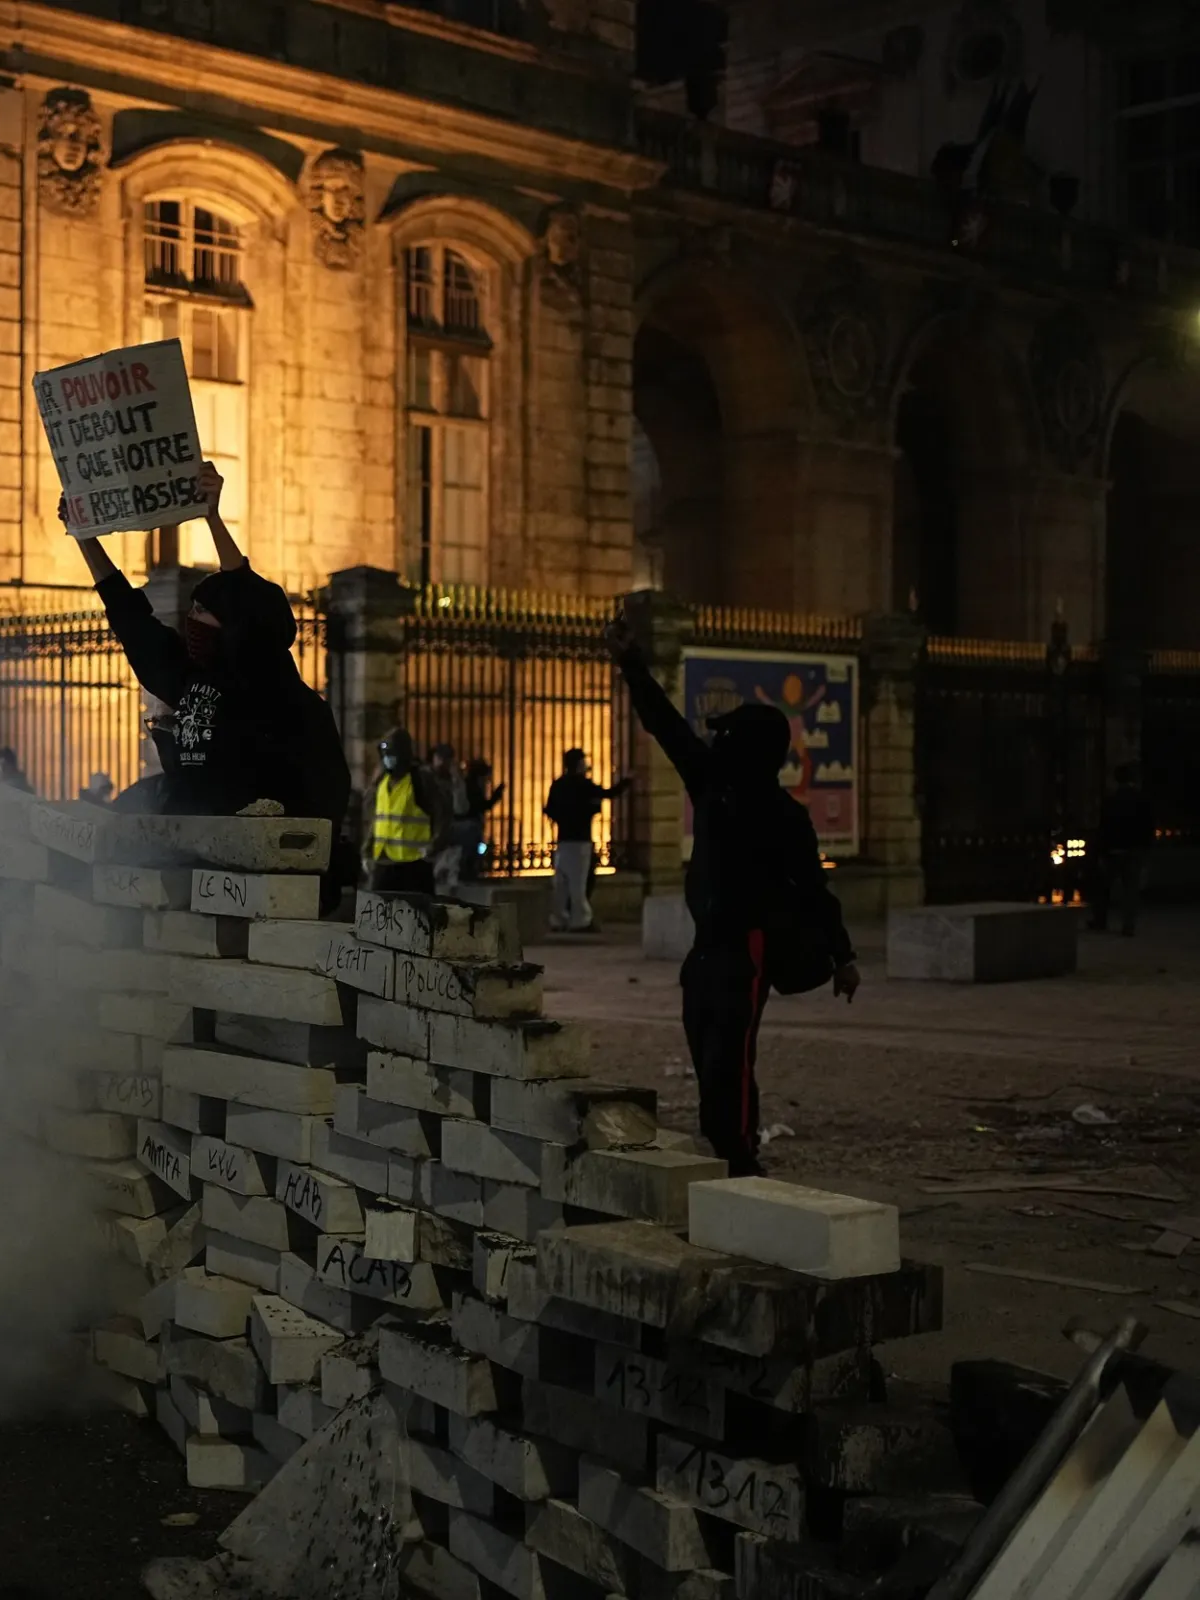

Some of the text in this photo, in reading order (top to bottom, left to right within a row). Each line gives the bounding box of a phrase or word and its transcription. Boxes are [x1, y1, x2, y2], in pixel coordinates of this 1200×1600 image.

[60, 362, 156, 411] POUVOIR
[68, 401, 156, 447] DEBOUT
[76, 449, 113, 484] QUE
[112, 433, 194, 473] NOTRE
[142, 1135, 182, 1180] ANTIFA
[606, 1359, 710, 1416] 1312
[674, 1445, 790, 1520] 1312
